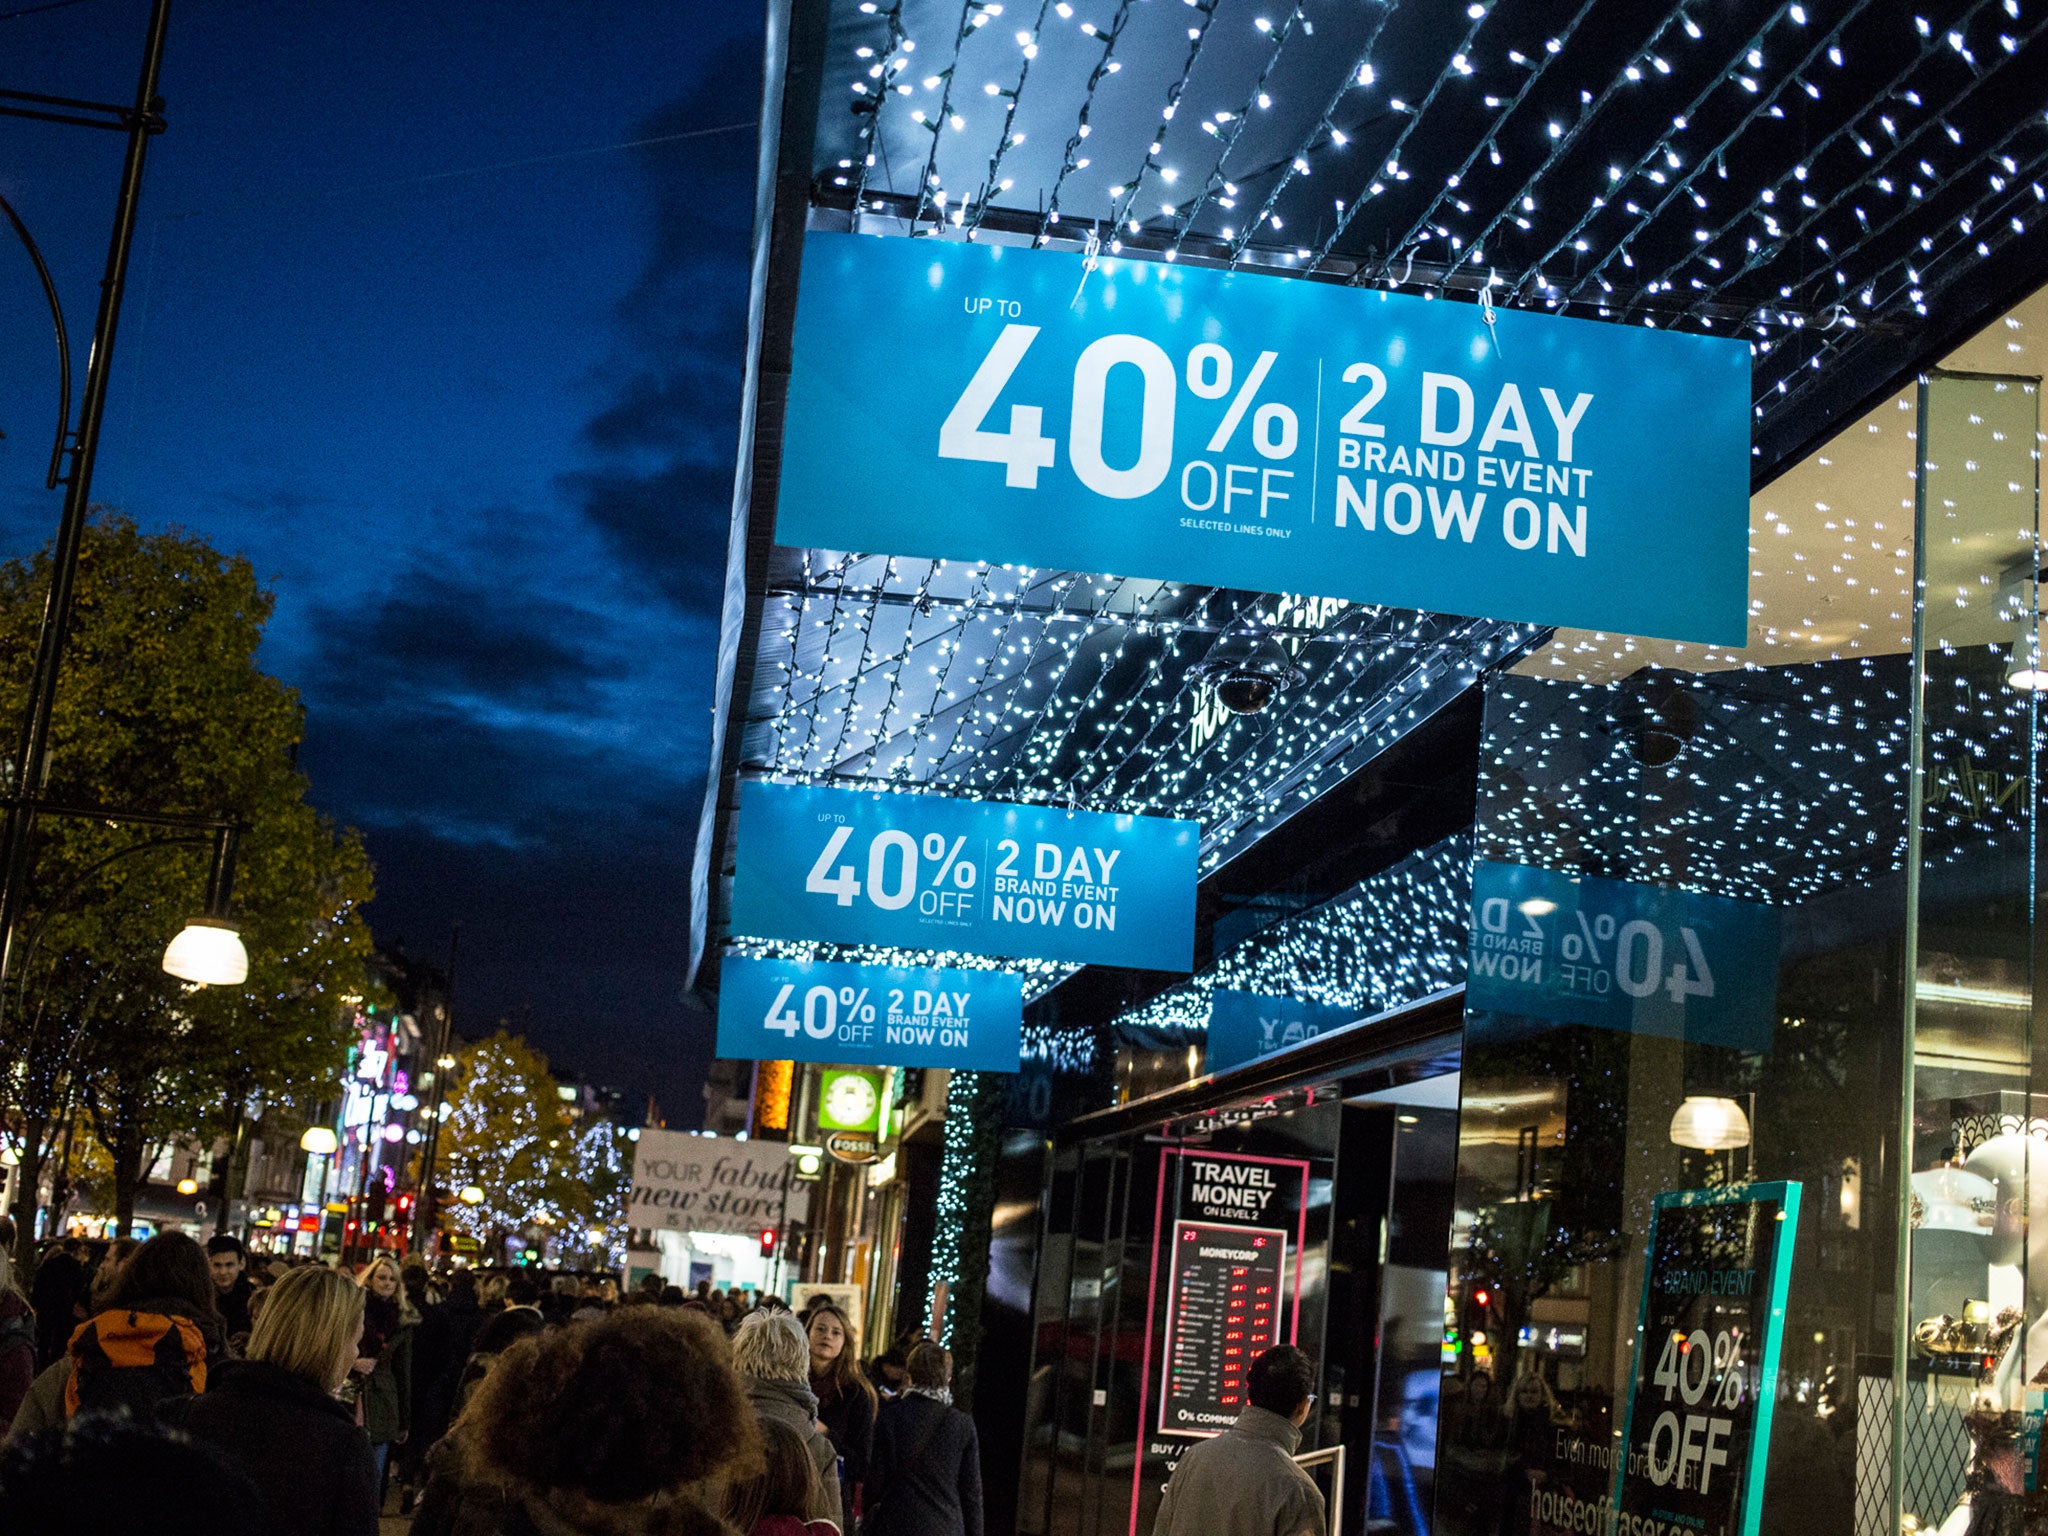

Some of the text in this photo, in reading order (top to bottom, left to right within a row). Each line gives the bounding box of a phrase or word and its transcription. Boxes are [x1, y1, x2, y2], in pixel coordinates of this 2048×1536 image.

[964, 297, 1021, 317] UP TO
[938, 323, 1298, 500] 40%
[1340, 362, 1594, 463] 2 DAY
[1338, 438, 1593, 498] BRAND EVENT
[1181, 460, 1294, 518] OFF
[1180, 517, 1292, 540] SELECTED LINES ONLY
[1335, 475, 1587, 557] NOW ON
[818, 813, 845, 823] UP TO
[806, 826, 976, 910] 40%
[996, 839, 1121, 885] 2 DAY
[995, 877, 1119, 902] BRAND EVENT
[920, 890, 974, 917] OFF
[993, 895, 1115, 931] NOW ON
[764, 984, 875, 1040] 40%
[887, 989, 971, 1017] 2 DAY
[838, 1024, 874, 1042] OFF
[887, 1014, 970, 1029] BRAND EVENT
[886, 1026, 968, 1048] NOW ON
[833, 1139, 876, 1153] FOSSIL
[643, 1159, 701, 1182] YOUR
[1192, 1162, 1276, 1188] TRAVEL
[631, 1185, 784, 1218] new store
[1192, 1183, 1272, 1209] MONEY
[1203, 1206, 1259, 1219] ON LEVEL 2
[1199, 1246, 1259, 1260] MONEYCORP
[1664, 1270, 1755, 1295] BRAND EVENT
[1653, 1329, 1744, 1411] 40%
[1178, 1409, 1195, 1421] 0%
[1151, 1444, 1174, 1454] BUY
[1555, 1429, 1585, 1463] Even
[1588, 1447, 1624, 1473] more
[1648, 1410, 1732, 1494] OFF
